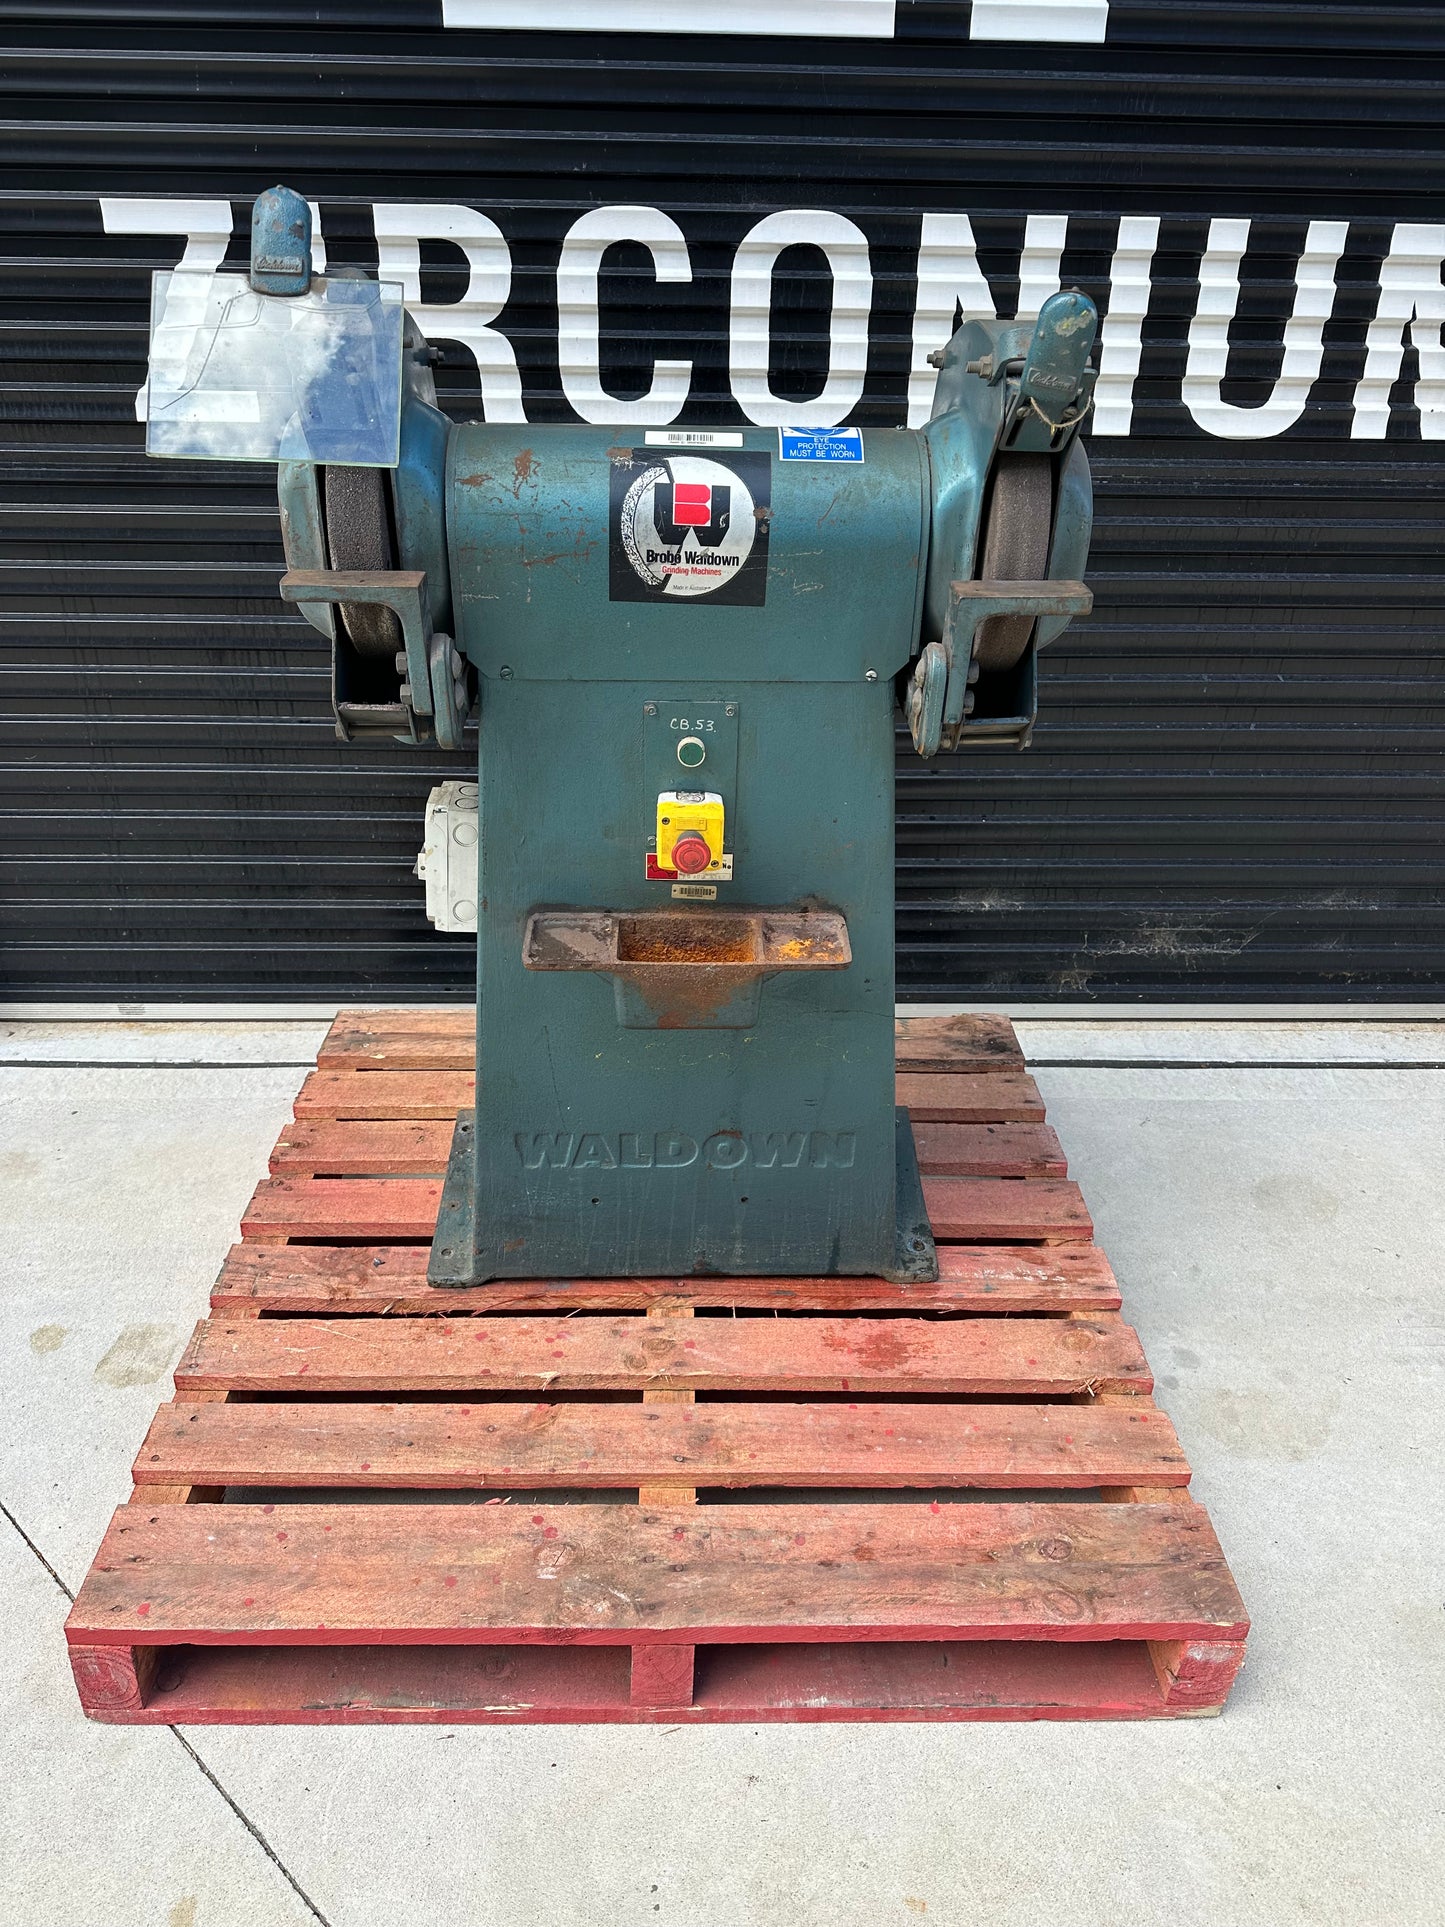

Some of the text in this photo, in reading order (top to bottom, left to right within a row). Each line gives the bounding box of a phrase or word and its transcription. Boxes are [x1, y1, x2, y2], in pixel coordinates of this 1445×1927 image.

[797, 442, 847, 450] PROTECTION
[789, 449, 856, 458] MUST BE WORN
[661, 565, 722, 576] Grinding Machines
[514, 1130, 857, 1170] WALDOWN
